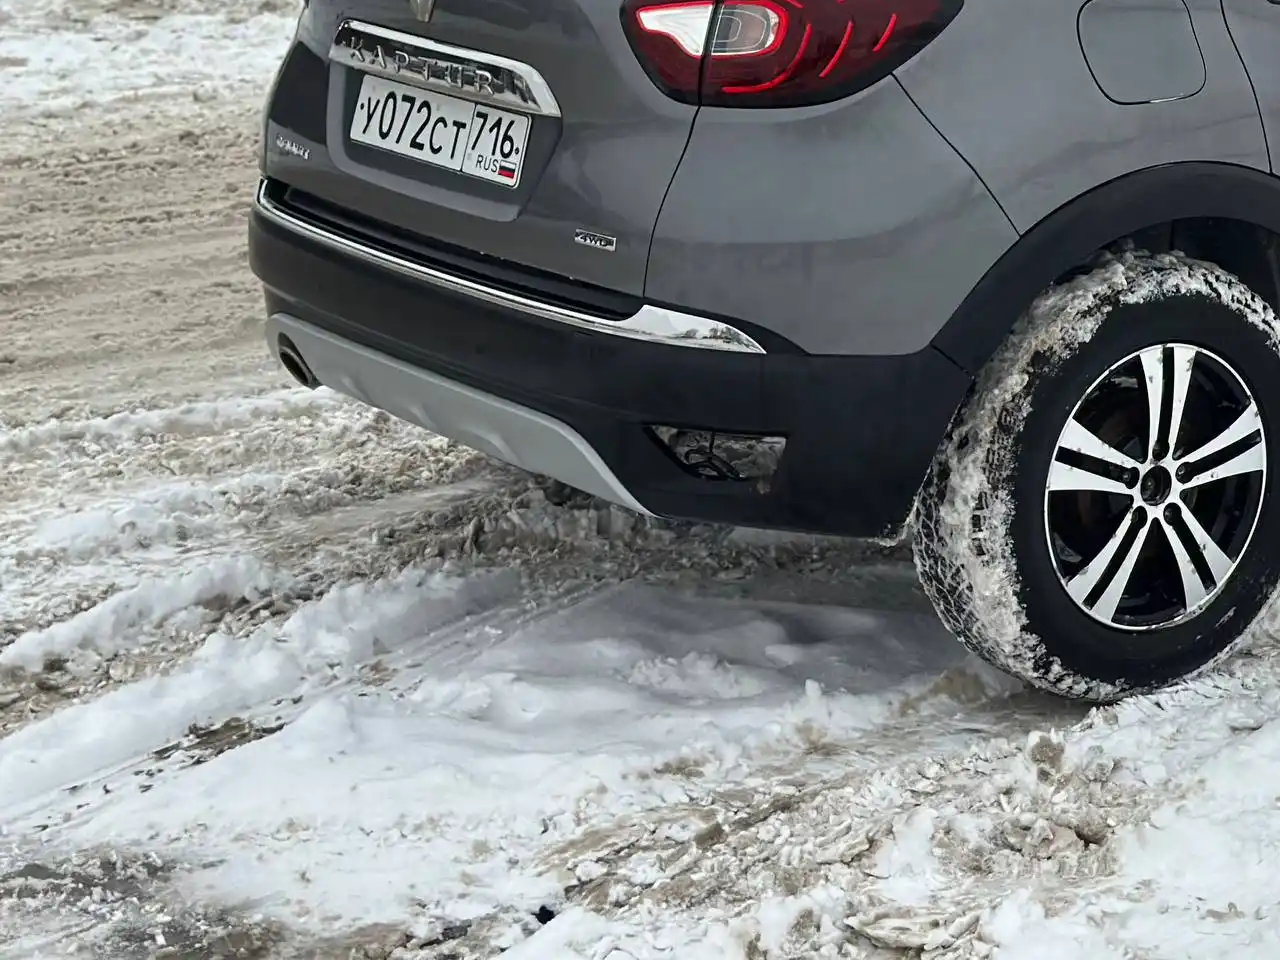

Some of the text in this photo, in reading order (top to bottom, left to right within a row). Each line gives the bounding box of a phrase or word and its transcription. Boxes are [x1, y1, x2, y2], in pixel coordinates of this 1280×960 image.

[349, 35, 495, 96] KAPTUR
[471, 111, 515, 159] 716
[475, 154, 499, 173] RUS
